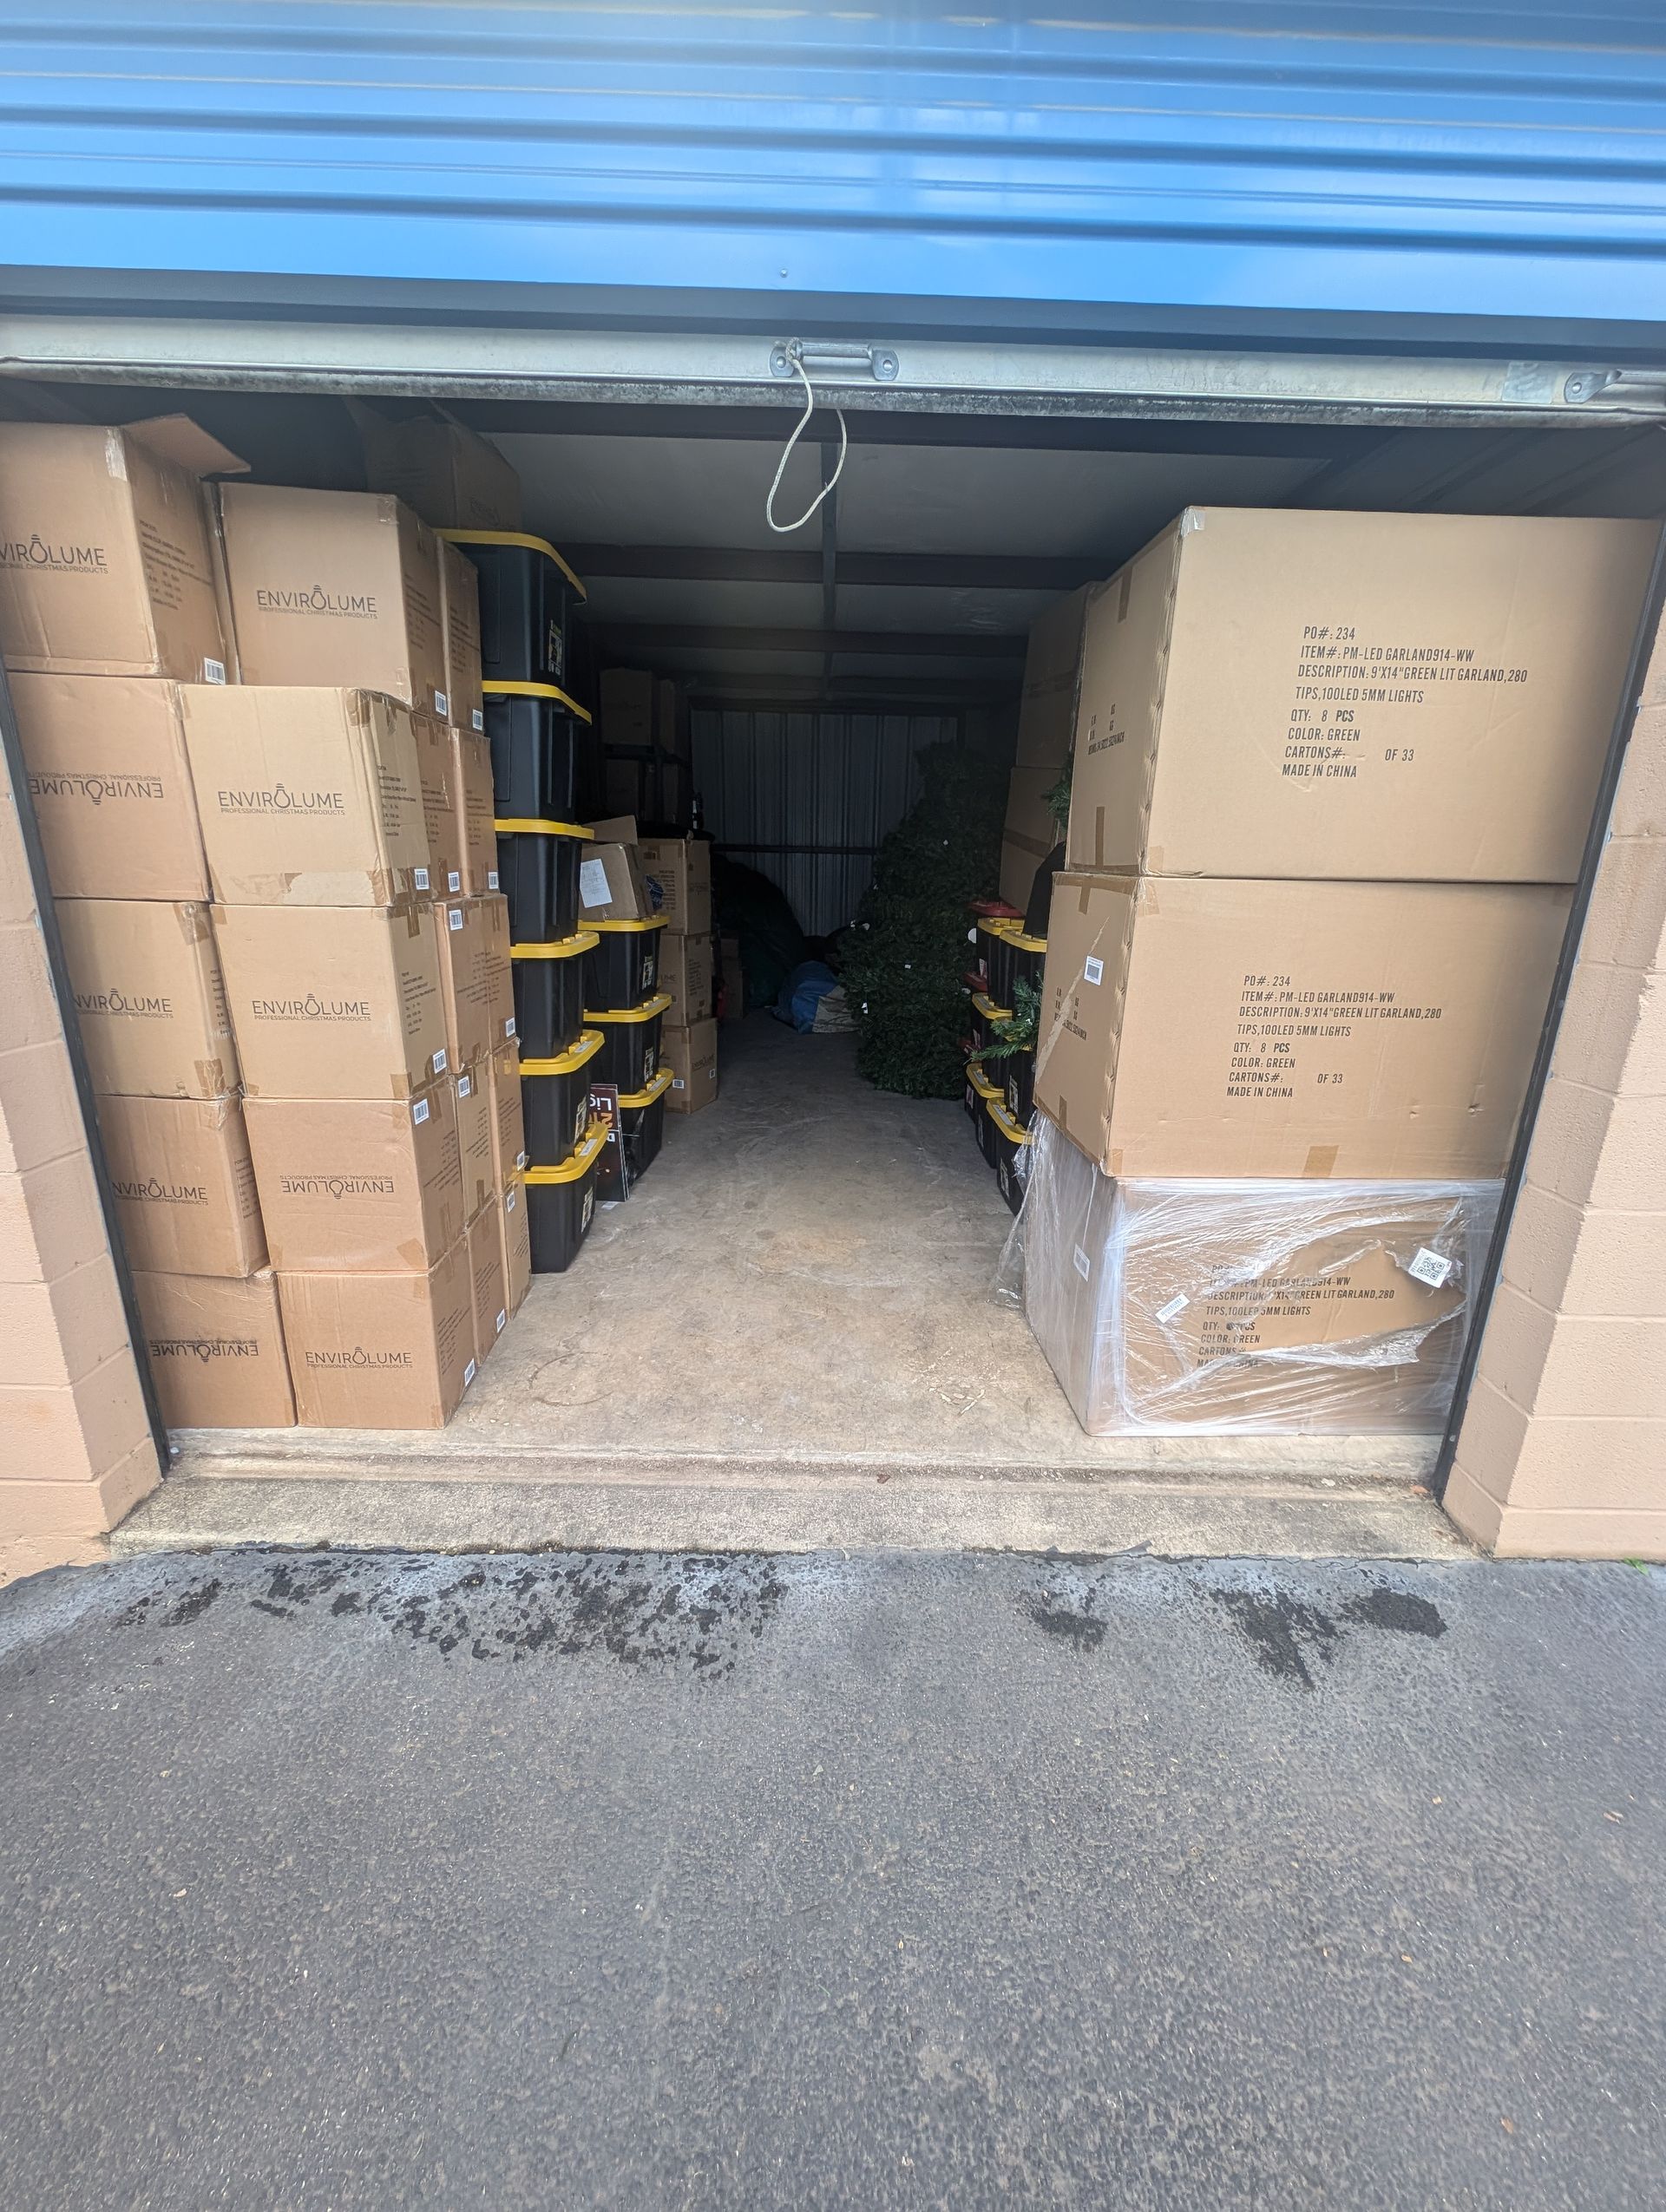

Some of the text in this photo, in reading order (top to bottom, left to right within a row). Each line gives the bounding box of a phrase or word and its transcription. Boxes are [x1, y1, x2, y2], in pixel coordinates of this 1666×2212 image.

[69, 566, 108, 574] PRODUCTS
[256, 585, 377, 612] ENVIROLUME
[306, 609, 343, 618] CHRISTMAS
[1303, 625, 1355, 640] PO#: 234
[1300, 645, 1474, 662] ITEM#: PM-LED GARLAND914-WW
[1298, 664, 1369, 678] DESCRIPTION:
[1440, 667, 1456, 681] LIT
[1457, 668, 1528, 683] GARLAND,280
[1295, 686, 1425, 704] TIPS,100LED 5MM LIGHTS
[1290, 709, 1354, 723] QTY: 8 PCS
[1288, 728, 1361, 742] COLOR: GREEN
[1385, 749, 1398, 761] OF
[1401, 749, 1414, 762] 33
[1282, 764, 1357, 777] MADE IN CHINA
[30, 779, 164, 805] ENVIROLUME
[218, 783, 344, 808] ENVIROLUME
[1243, 975, 1290, 986] PO#: 234
[1241, 991, 1395, 1003] ITEM#: PM-LED GARLAND914-WW
[252, 993, 371, 1016] ENVIROLUME
[1239, 1006, 1302, 1018] DESCRIPTION:
[1364, 1008, 1379, 1018] LIT
[1380, 1008, 1442, 1020] GARLAND,280
[1237, 1024, 1352, 1037] TIPS,100LED 5MM LIGHTS
[1234, 1043, 1290, 1053] QTY: 8 PCS
[1231, 1057, 1295, 1068] COLOR: GREEN
[1229, 1072, 1343, 1083] CARTONS#: OF 33
[1227, 1086, 1293, 1097] MADE IN CHINA
[281, 1180, 394, 1199] ENVIROLUME
[1323, 1290, 1336, 1299] LIT
[1337, 1289, 1394, 1300] GARLAND,280
[1261, 1306, 1281, 1316] 5MM
[1282, 1306, 1311, 1316] LIGHTS
[1203, 1321, 1220, 1331] QTY:
[1201, 1334, 1230, 1344] COLOR:
[152, 1345, 259, 1363] ENVIROLUME
[305, 1346, 412, 1365] ENVIROLUME
